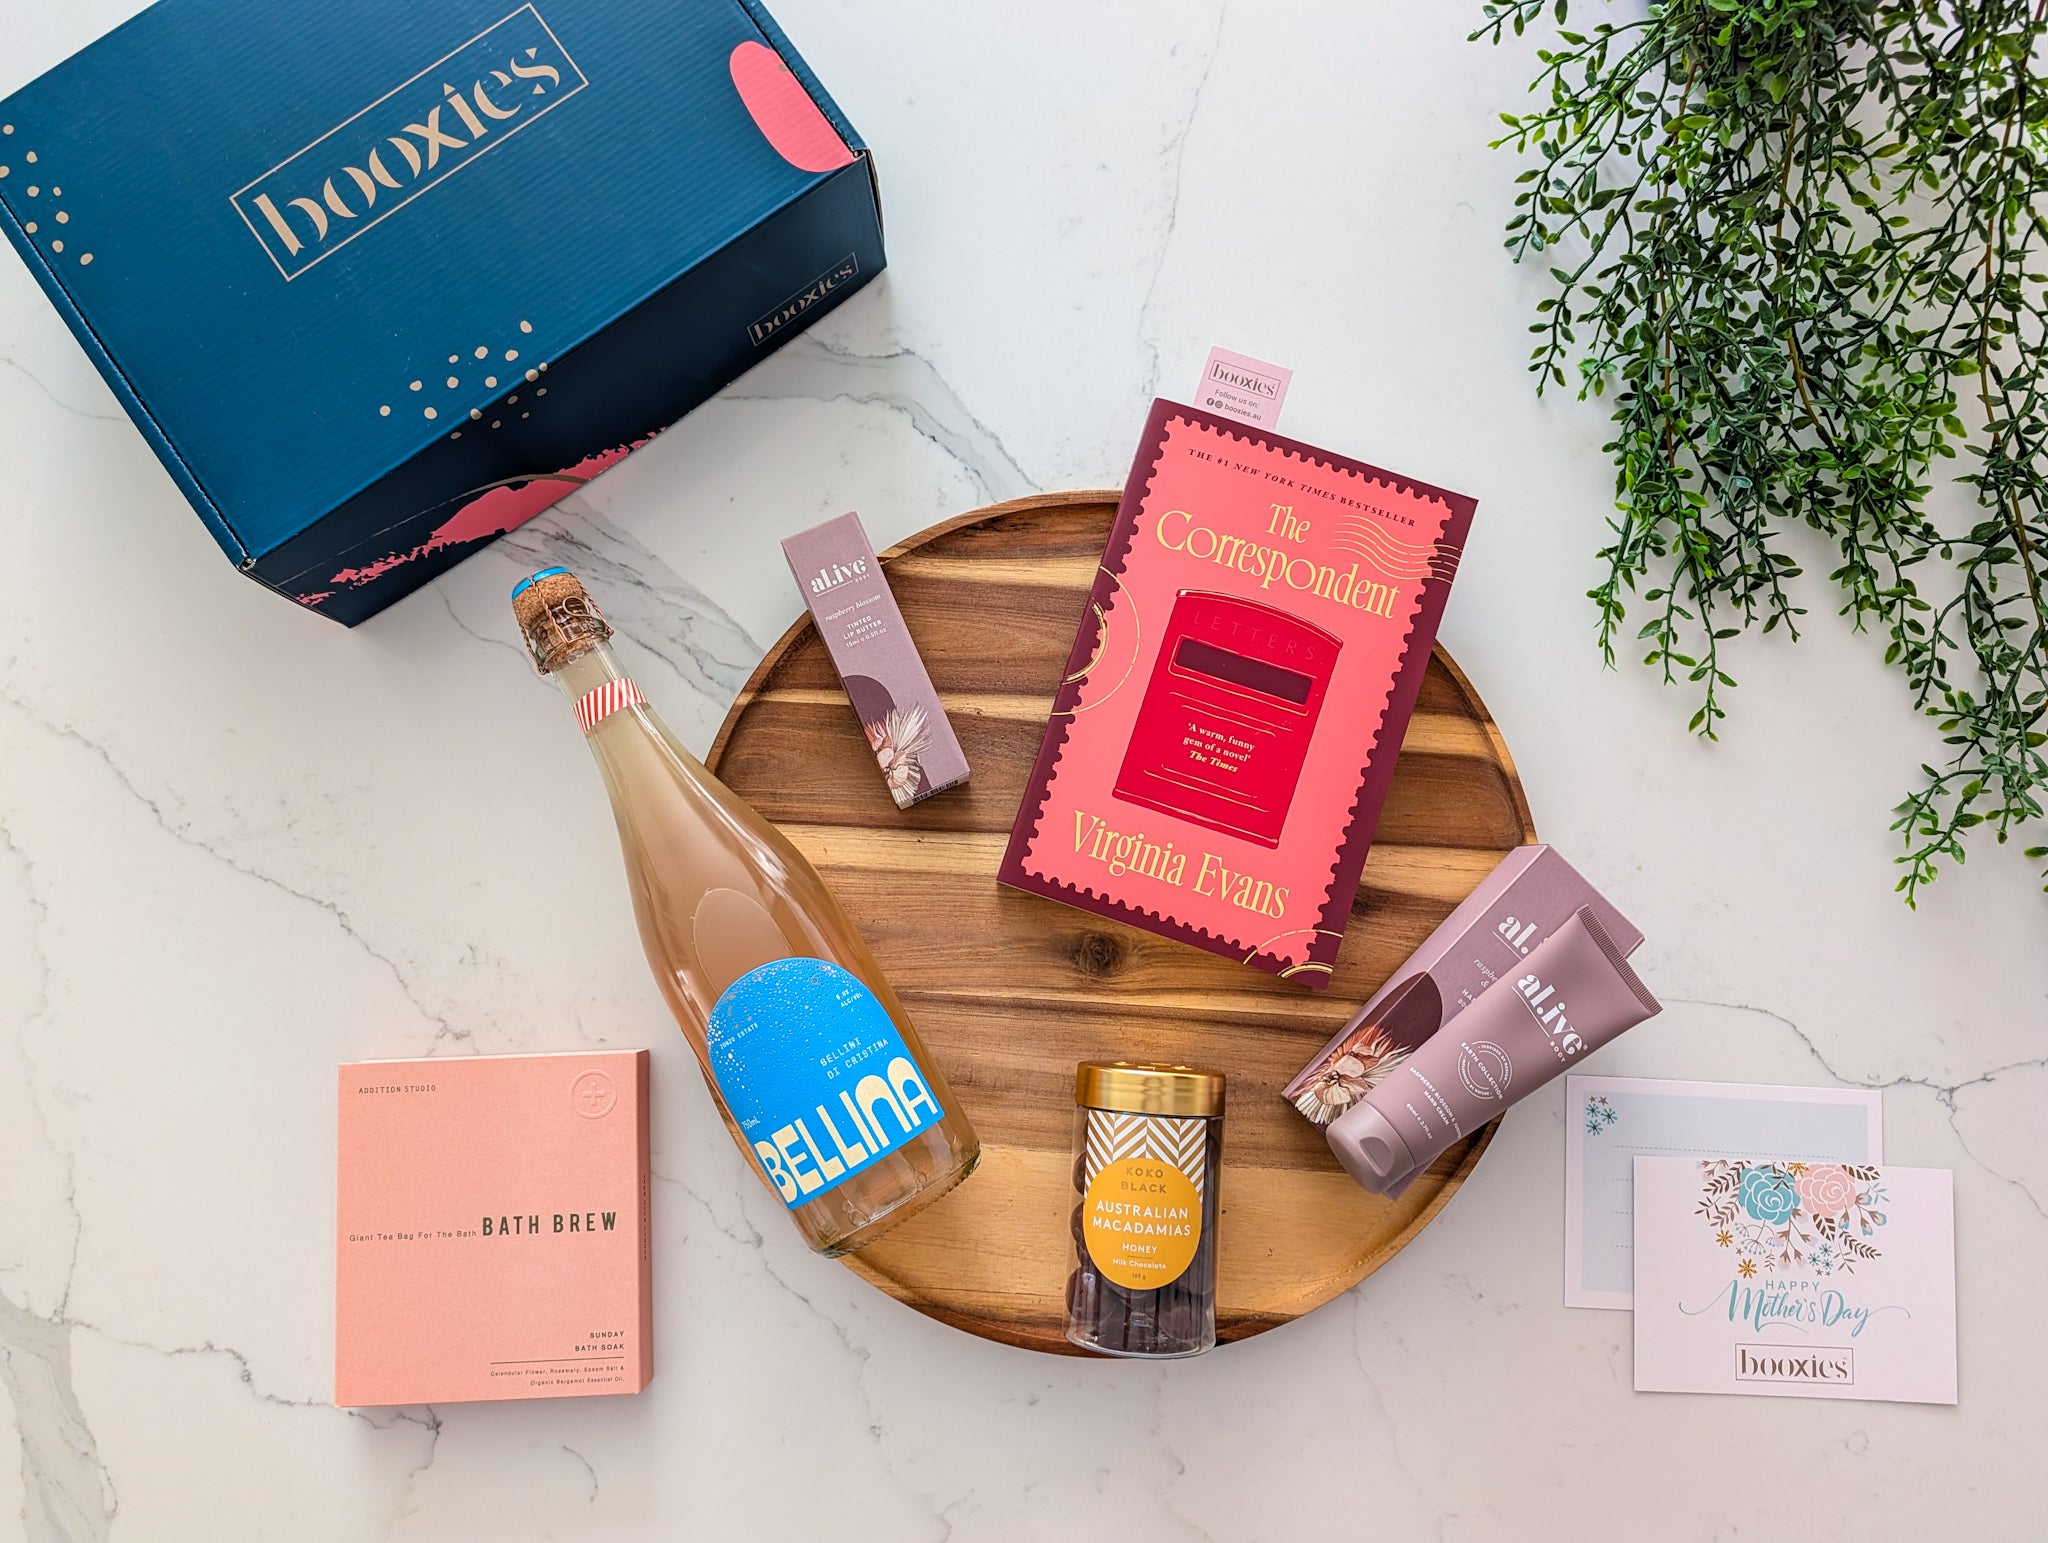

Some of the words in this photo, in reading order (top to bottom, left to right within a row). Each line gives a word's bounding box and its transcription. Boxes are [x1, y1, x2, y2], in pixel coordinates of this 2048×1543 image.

[252, 47, 560, 257] booxies
[753, 265, 853, 340] booxies
[1212, 363, 1276, 396] booxies
[1214, 388, 1237, 402] Follow
[1238, 397, 1247, 405] us
[1248, 399, 1259, 409] on:
[1224, 403, 1262, 420] booxies.au
[1188, 448, 1213, 462] THE
[1217, 457, 1229, 467] #1
[1233, 462, 1261, 476] NEW
[1264, 471, 1295, 488] YORK
[1299, 483, 1337, 501] TIMES
[1339, 496, 1416, 527] BESTSELLER
[1265, 502, 1311, 543] The
[1156, 510, 1401, 619] Correspondent
[825, 604, 855, 622] raspberry
[855, 594, 881, 609] blossom
[843, 631, 855, 640] LIP
[856, 619, 882, 635] BUTTER
[846, 615, 872, 630] TINTED
[1192, 608, 1316, 661] LETTERS
[1182, 736, 1203, 748] gem
[1204, 743, 1216, 751] of
[1199, 727, 1226, 743] warm,
[1228, 735, 1255, 752] funny
[1189, 750, 1208, 763] The
[1209, 756, 1239, 773] Times
[1074, 809, 1187, 887] Virginia
[1192, 851, 1290, 919] Evans
[1498, 916, 1549, 954] al.
[1473, 958, 1499, 982] raspbe
[737, 1022, 759, 1040] ESTATE
[819, 1037, 862, 1067] BELLINI
[827, 1067, 841, 1080] DI
[845, 1038, 889, 1069] CRISTINA
[1549, 1040, 1567, 1063] BODY
[1461, 1041, 1479, 1063] EARTH
[1478, 1062, 1504, 1100] COLLECTION
[358, 1085, 401, 1095] ADDITION
[404, 1084, 437, 1093] STUDIO
[1409, 1066, 1436, 1093] RASPBERRY
[1434, 1090, 1454, 1118] BLOSSOM
[1423, 1090, 1438, 1107] HAND
[1436, 1106, 1450, 1126] CREAM
[754, 1056, 938, 1204] BELLINA
[1126, 1166, 1164, 1178] KOKO
[1121, 1180, 1167, 1194] BLACK
[1096, 1199, 1188, 1220] AUSTRALIAN
[349, 1233, 373, 1242] Giant
[377, 1233, 394, 1241] Tea
[397, 1232, 414, 1243] Bag
[418, 1231, 432, 1239] For
[456, 1229, 477, 1237] Bath
[482, 1215, 540, 1237] BATH
[553, 1211, 617, 1234] BREW
[1092, 1215, 1191, 1237] MACADAMIAS
[1122, 1242, 1158, 1254] HONEY
[1112, 1257, 1127, 1266] Milk
[1129, 1259, 1166, 1270] Chocolate
[1765, 1279, 1821, 1292] HAPPY
[1679, 1279, 1817, 1333] Mother's
[589, 1330, 625, 1339] SUNDAY
[575, 1344, 598, 1352] BATH
[601, 1343, 625, 1351] SOAK
[525, 1368, 548, 1376] Flower,
[550, 1366, 582, 1375] Rosemary,
[583, 1366, 604, 1374] Epsom
[1741, 1349, 1848, 1379] booxies
[530, 1379, 554, 1387] Organic
[556, 1378, 585, 1386] Bergamot
